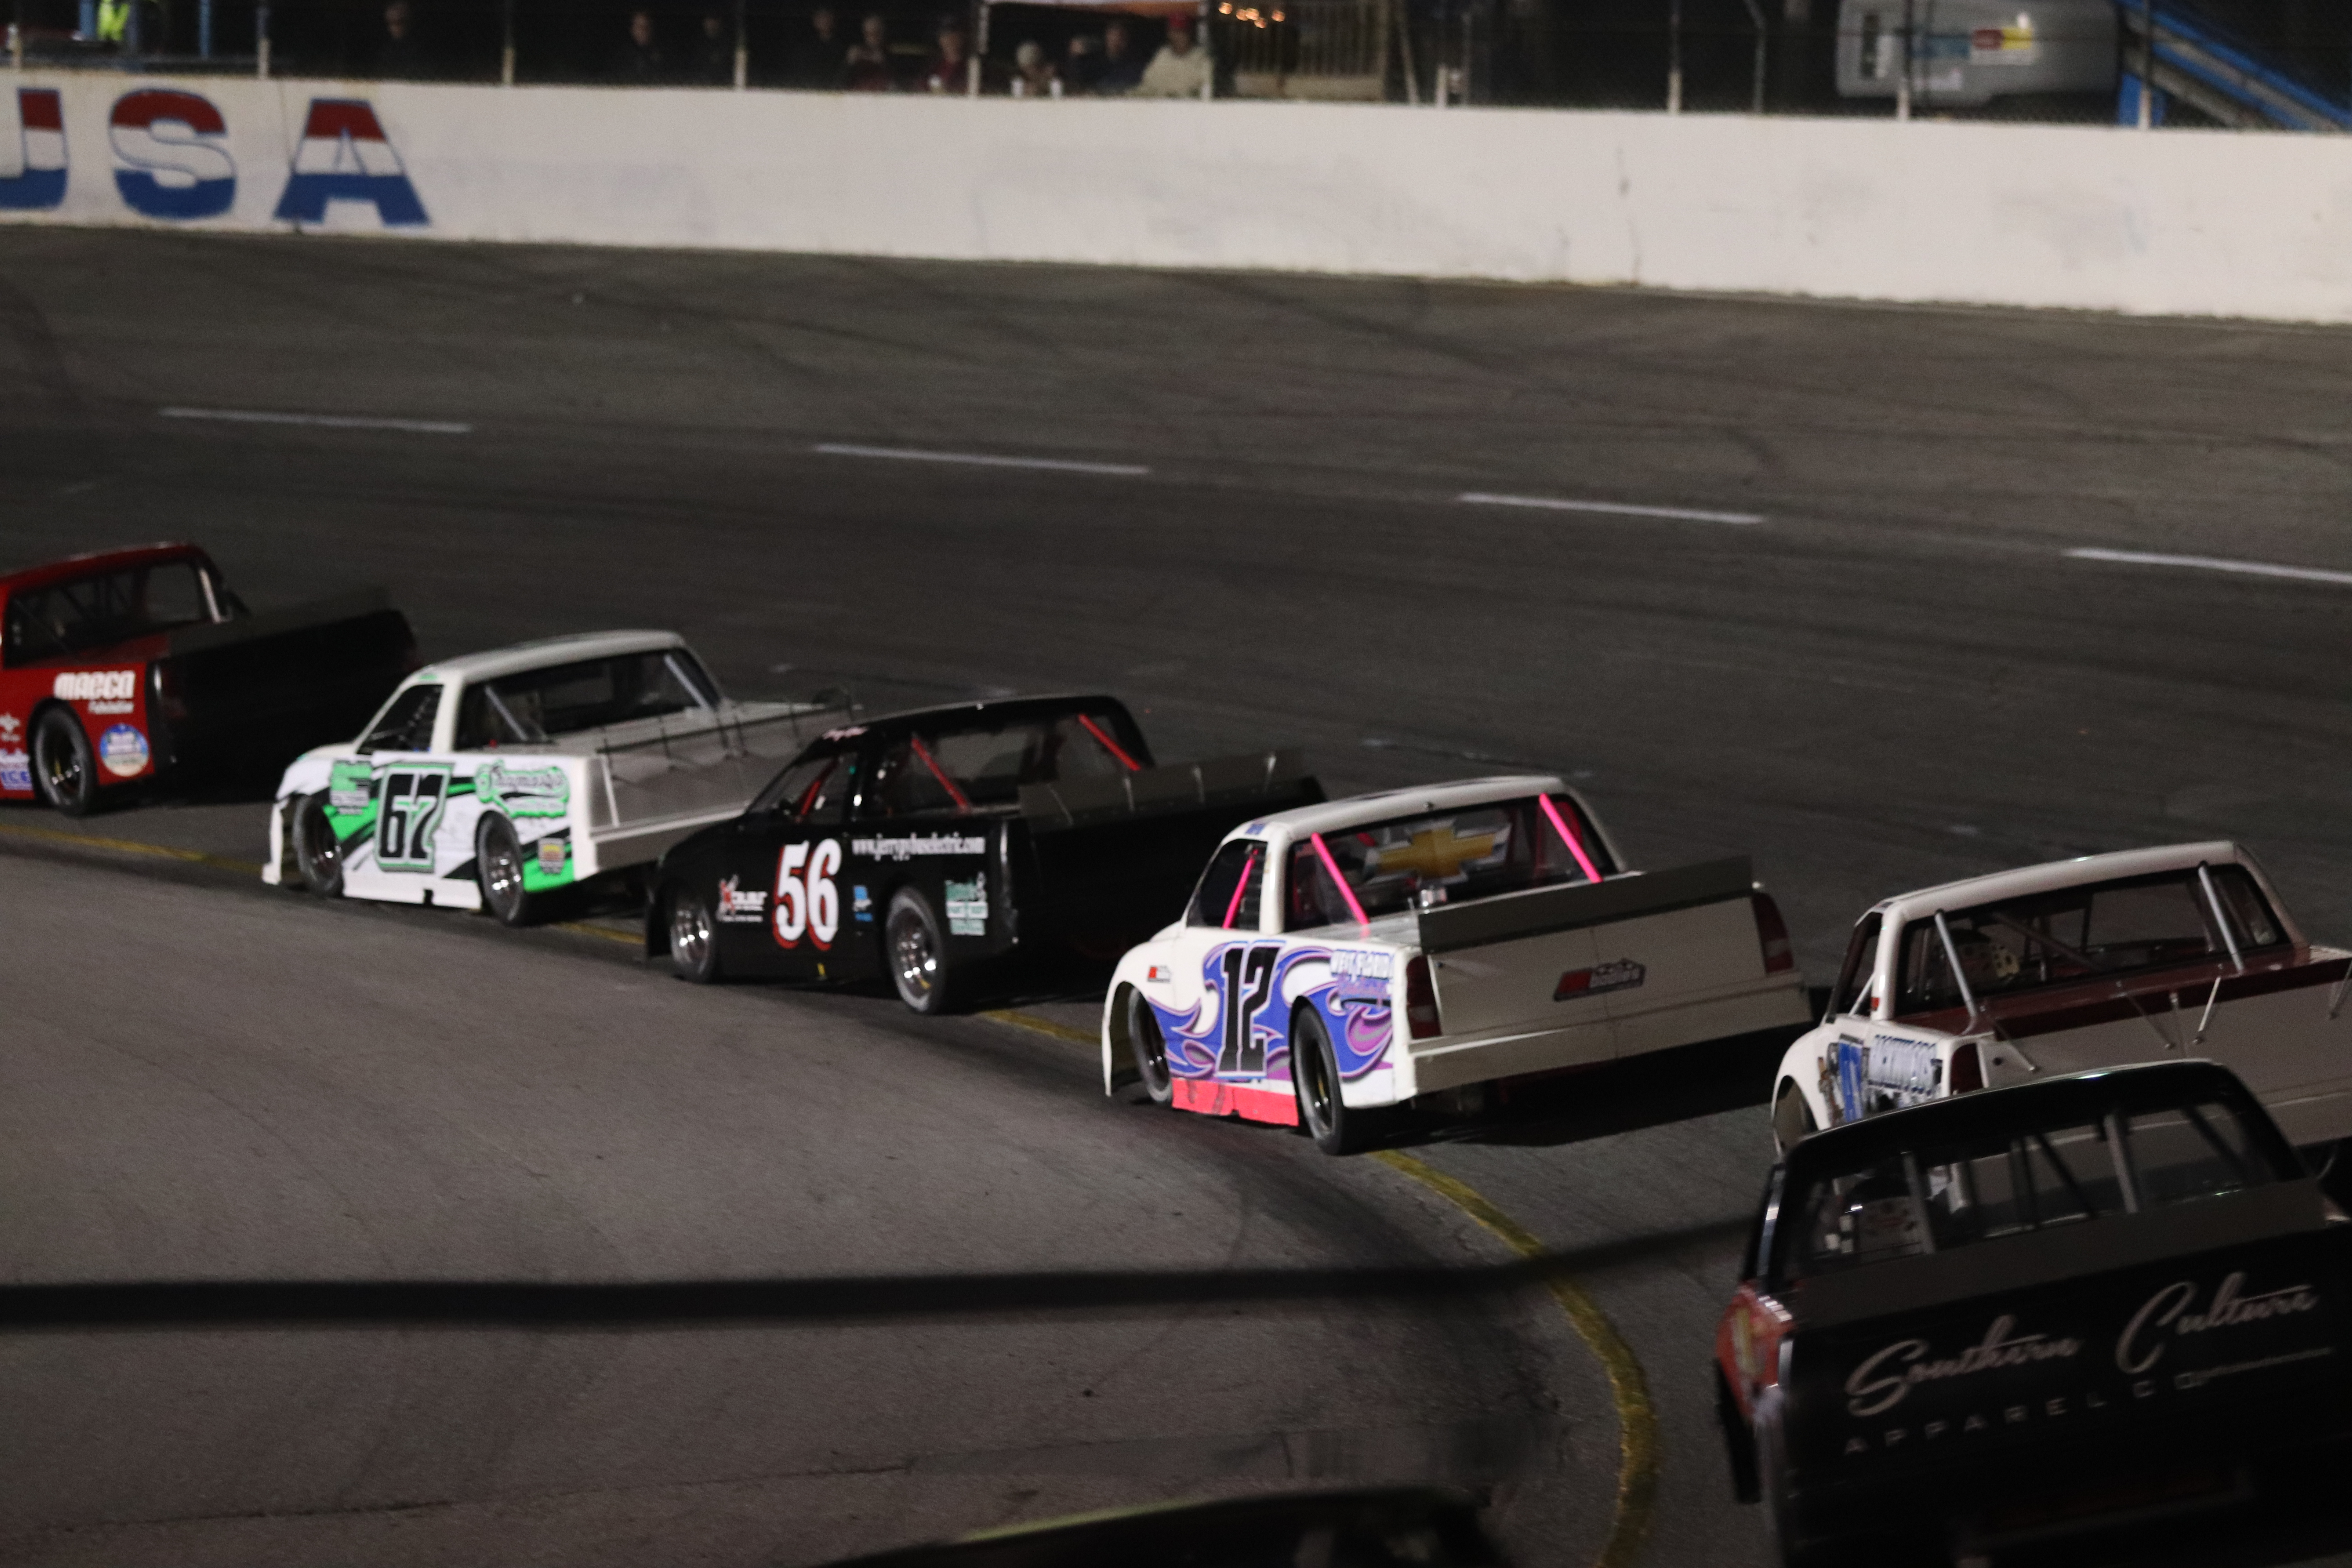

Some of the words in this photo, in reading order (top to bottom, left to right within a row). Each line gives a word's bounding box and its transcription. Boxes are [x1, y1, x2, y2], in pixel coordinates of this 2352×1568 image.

[0, 88, 432, 227] USA
[375, 767, 452, 867] 67
[772, 838, 842, 948] 56
[1217, 944, 1284, 1075] 12
[1845, 1314, 2084, 1417] Southern
[2116, 1271, 2319, 1374] Culture
[1844, 1392, 2107, 1455] APPAREL
